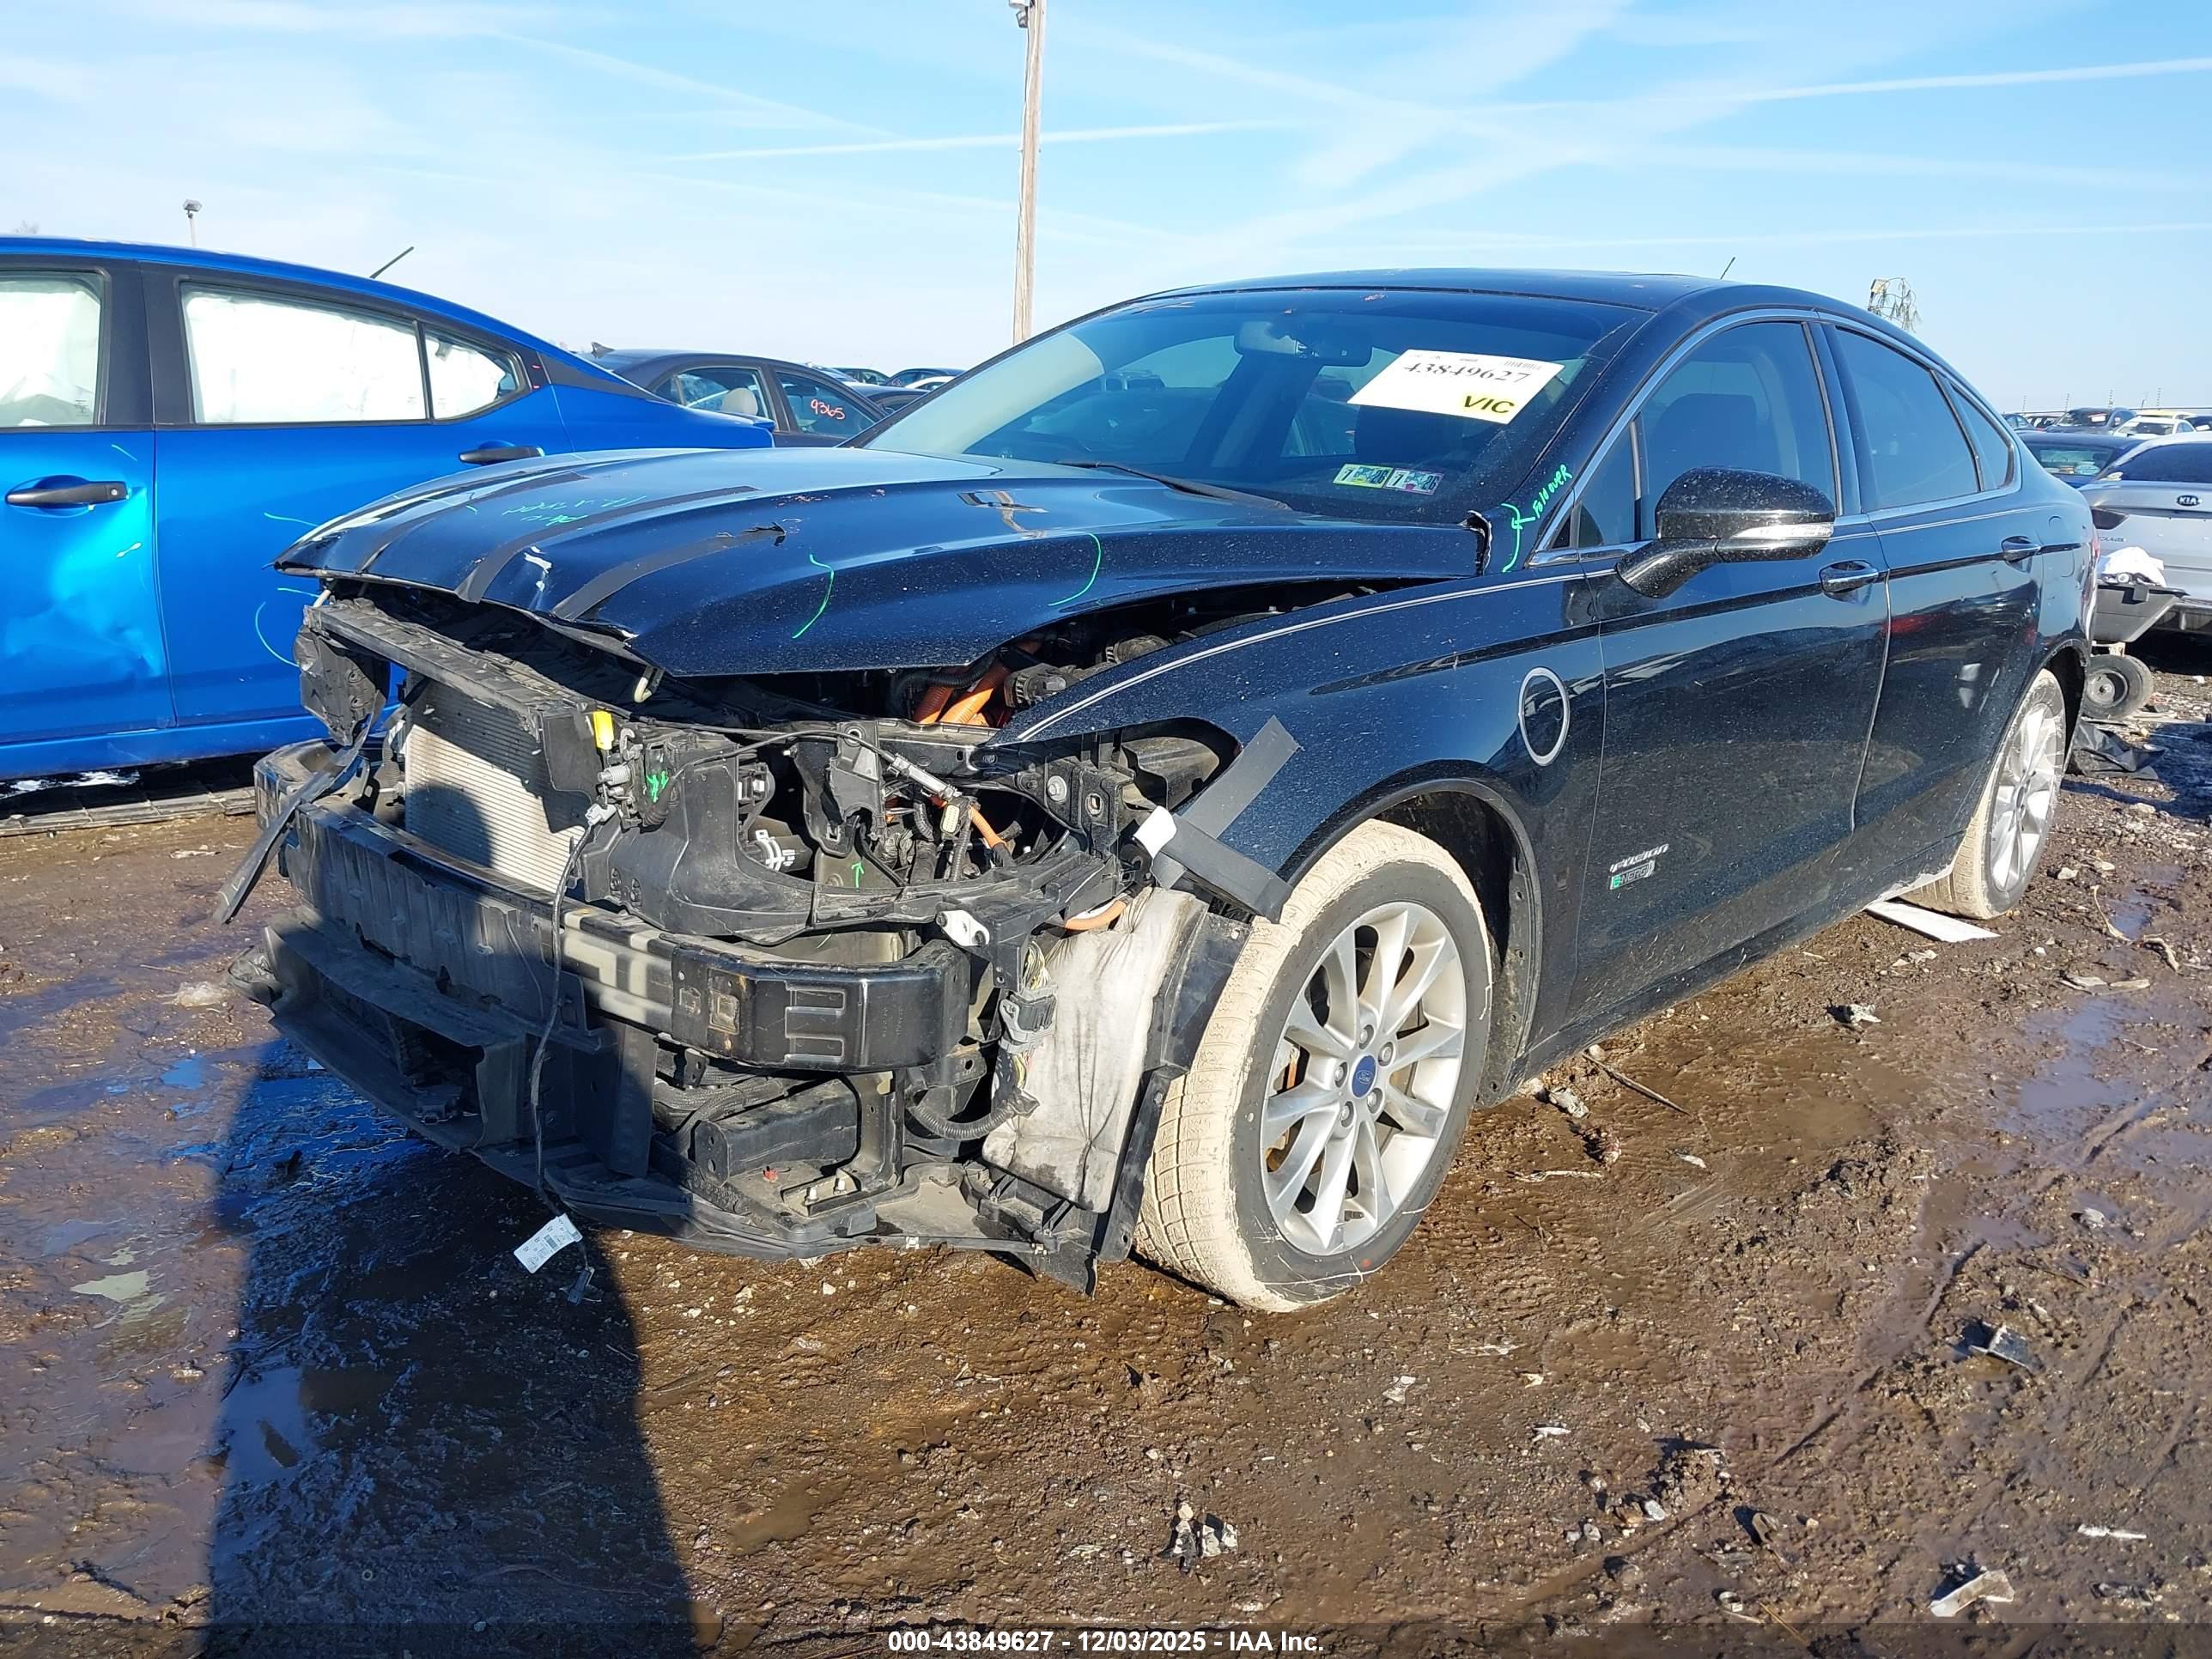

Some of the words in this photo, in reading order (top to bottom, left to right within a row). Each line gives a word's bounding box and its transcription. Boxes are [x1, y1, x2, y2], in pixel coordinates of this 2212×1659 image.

[1404, 362, 1531, 383] 43849627
[811, 398, 845, 420] 9365
[1462, 395, 1515, 414] VIC
[1341, 469, 1353, 482] 7
[1371, 469, 1389, 485] 26
[1393, 473, 1404, 486] 7
[1421, 475, 1440, 490] 26
[2179, 496, 2198, 505] KIA
